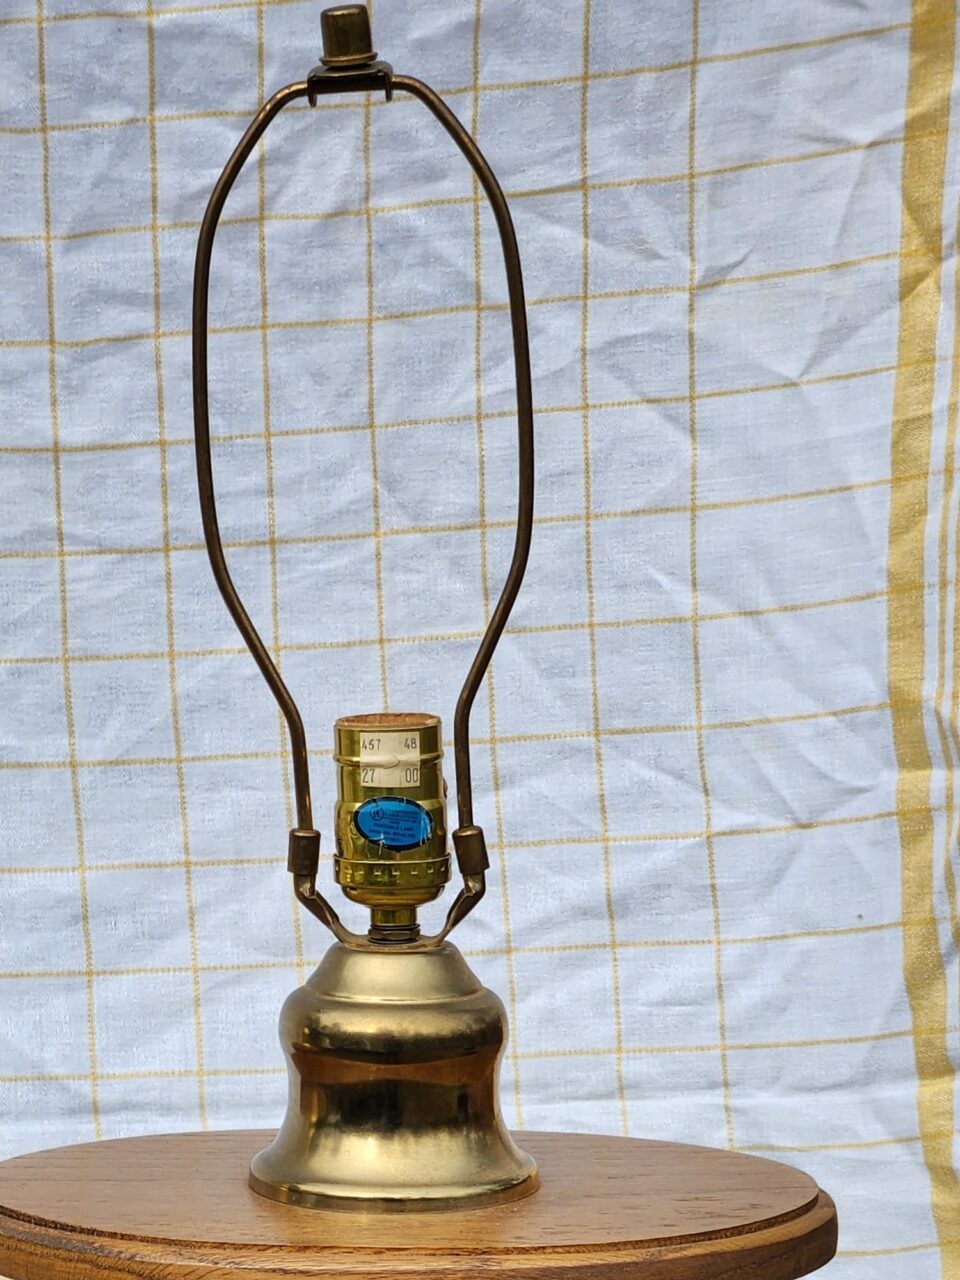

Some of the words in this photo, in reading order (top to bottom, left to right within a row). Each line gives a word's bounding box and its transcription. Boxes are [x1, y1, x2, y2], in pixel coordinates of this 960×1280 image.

[404, 737, 418, 750] 48
[362, 768, 375, 784] 27
[405, 767, 419, 784] 00
